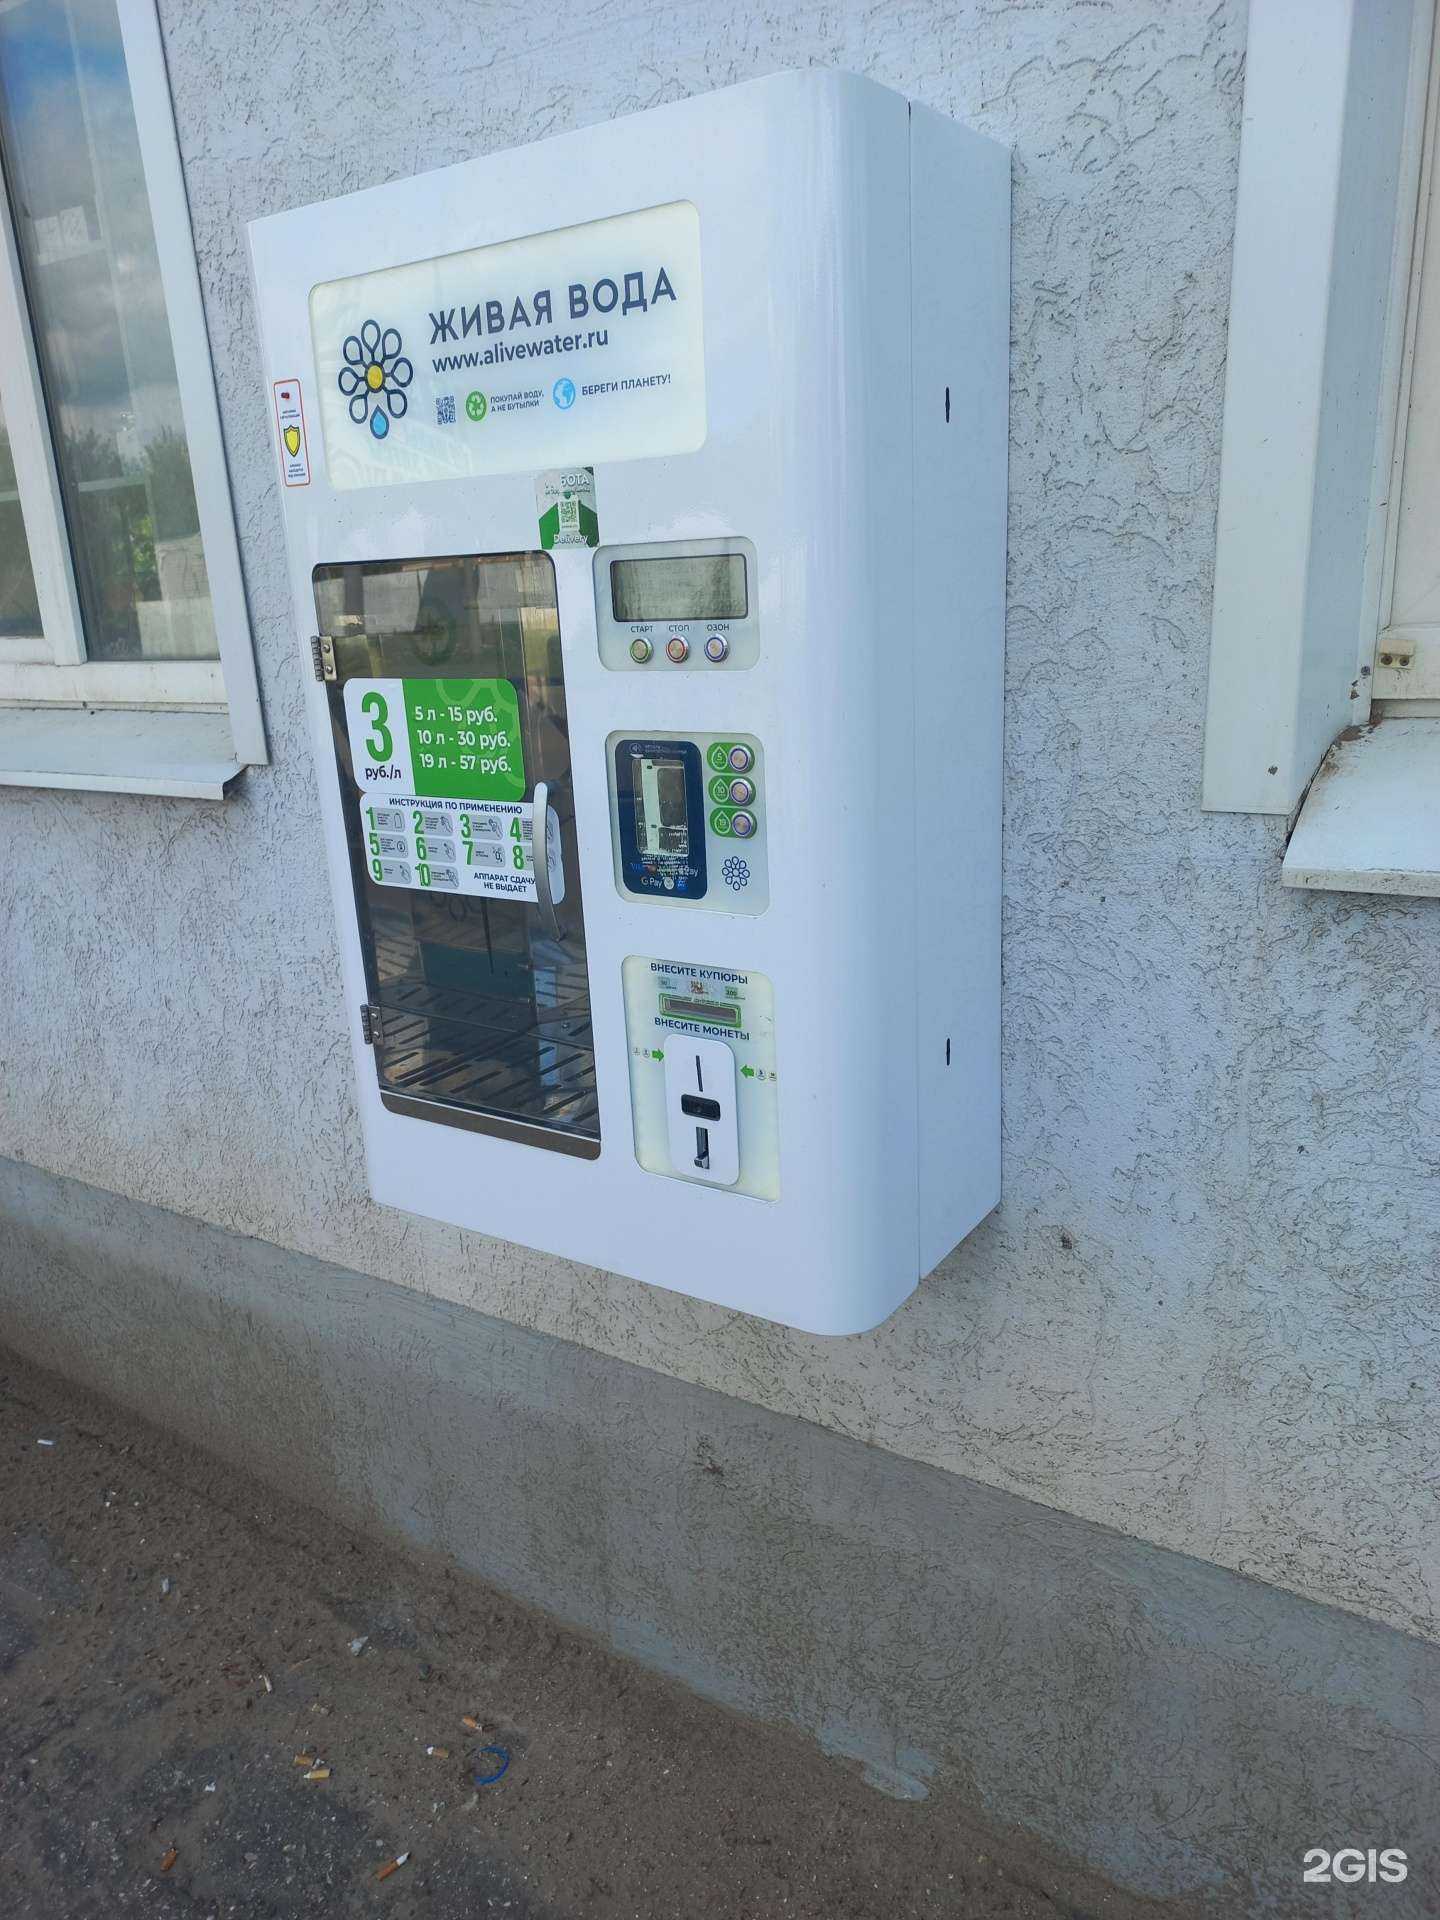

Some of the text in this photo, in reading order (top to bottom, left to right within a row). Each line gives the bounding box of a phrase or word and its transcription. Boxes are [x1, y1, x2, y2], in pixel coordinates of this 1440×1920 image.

[429, 266, 677, 344] ЖИВАЯ ВОДА
[432, 329, 608, 373] www.alivewater.ru
[582, 373, 671, 396] БЕРЕГИ ПЛАНЕТУ!
[490, 391, 523, 404] ПОКУПАЙ
[491, 399, 540, 413] А НЕ БУТЫЛКИ
[630, 625, 653, 633] СТАРТ
[668, 624, 690, 632] СТОП
[706, 623, 730, 632] ОЗОН
[361, 691, 393, 762] 3
[415, 706, 424, 721] 5
[427, 709, 437, 721] л
[447, 706, 463, 722] 15
[466, 705, 498, 725] руб.
[417, 729, 432, 745] 10
[435, 733, 445, 745] л
[457, 730, 476, 746] 30
[480, 731, 511, 750] руб.
[419, 753, 434, 769] 19
[438, 757, 447, 769] л
[460, 755, 476, 770] 57
[480, 755, 512, 774] руб.
[717, 752, 723, 761] 5
[365, 764, 402, 781] руб./л
[389, 797, 523, 814] ИНСТРУКЦИЯ ПО ПРИМЕНЕНИЮ
[365, 806, 376, 831] 1
[412, 810, 424, 835] 2
[459, 813, 471, 838] 3
[509, 816, 522, 843] 4
[368, 832, 380, 856] 5
[415, 836, 427, 861] 6
[462, 840, 474, 865] 7
[512, 845, 525, 870] 8
[372, 858, 383, 882] 9
[415, 862, 431, 887] 10
[473, 872, 536, 885] АППАРАТ СДАЧУ
[483, 881, 527, 893] НЕ ВЫДАЕТ
[650, 962, 748, 985] ВНЕСИТЕ КУПЮРЫ
[654, 1017, 750, 1041] ВНЕСИТЕ МОНЕТЫ
